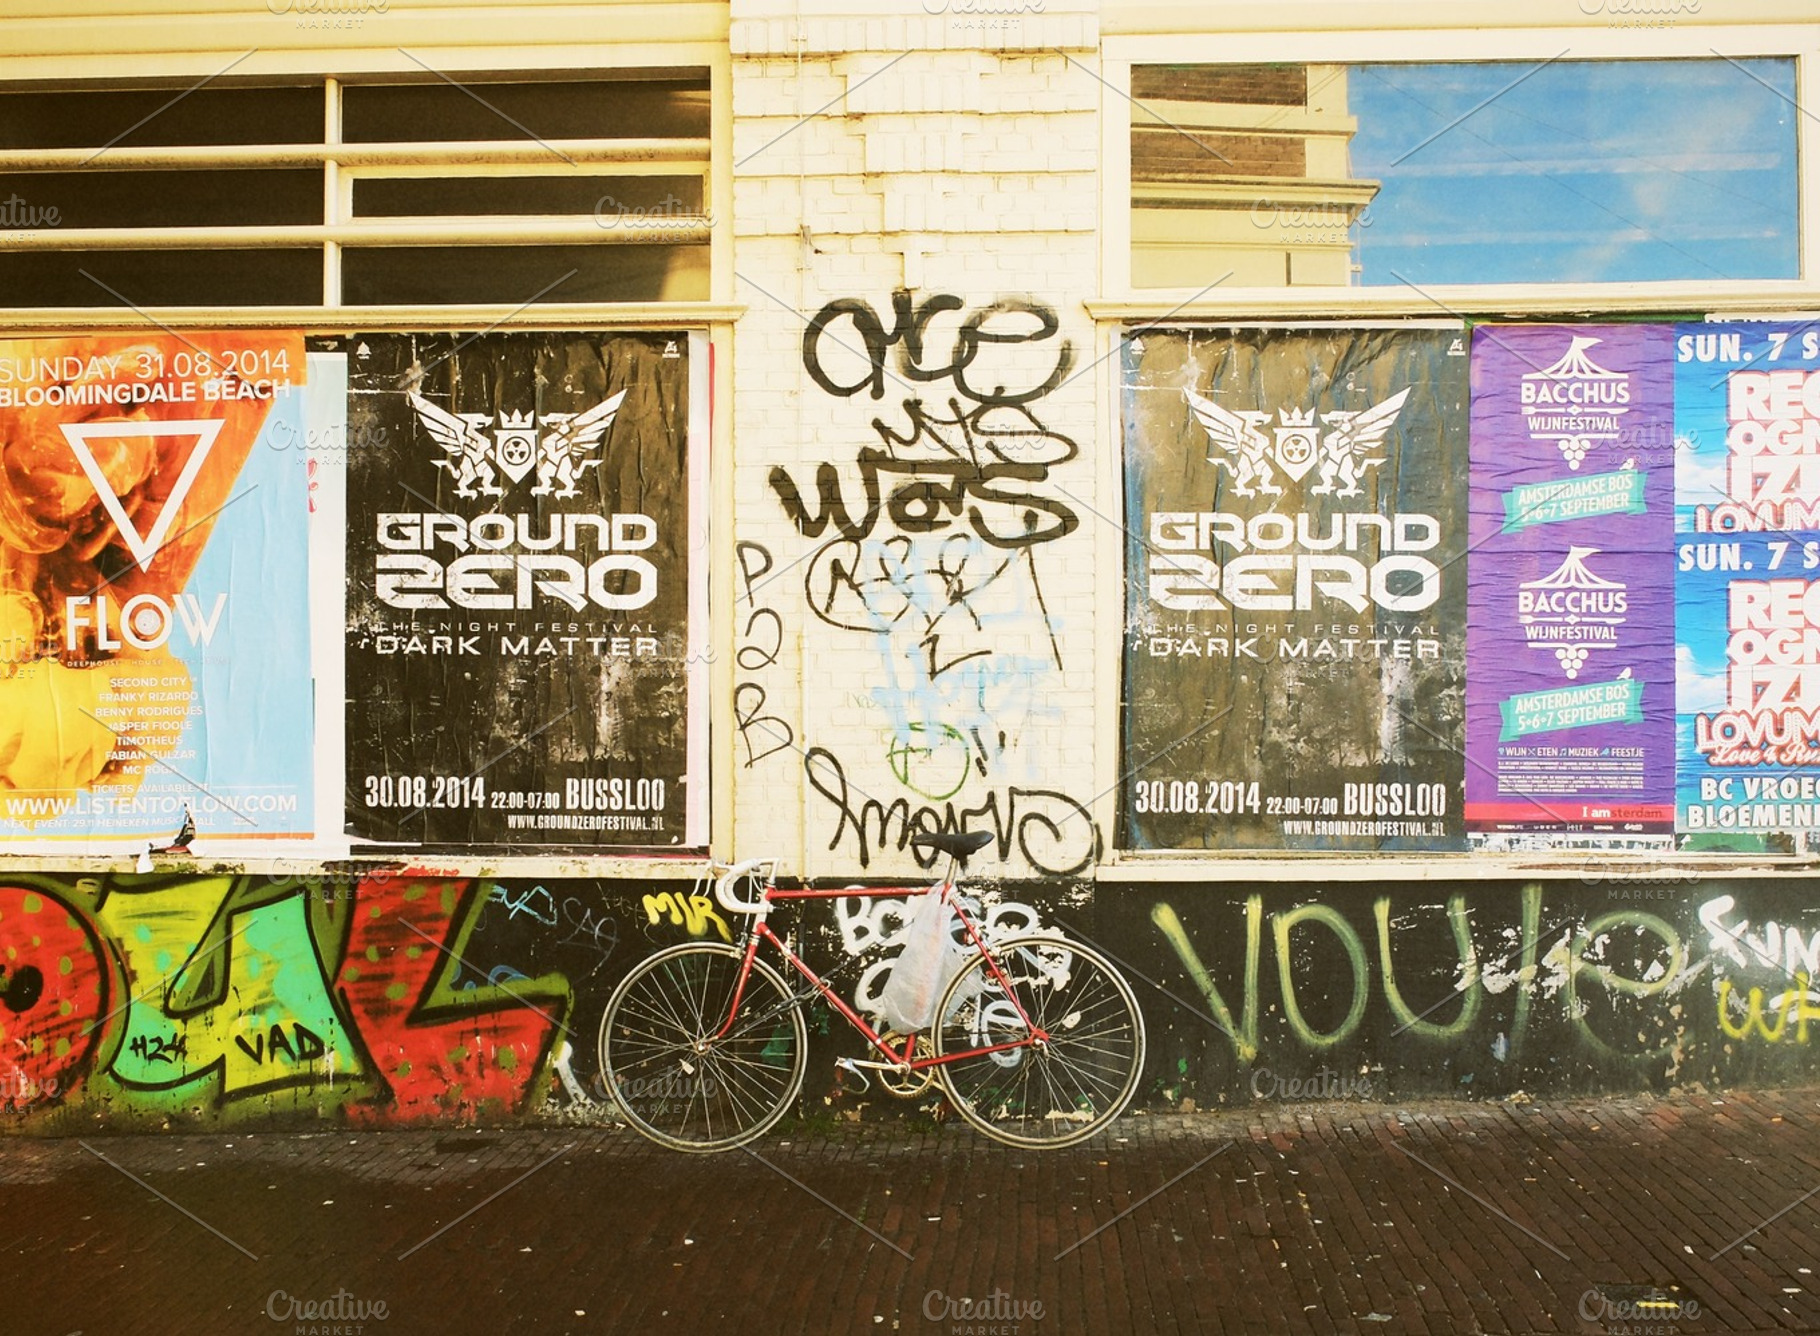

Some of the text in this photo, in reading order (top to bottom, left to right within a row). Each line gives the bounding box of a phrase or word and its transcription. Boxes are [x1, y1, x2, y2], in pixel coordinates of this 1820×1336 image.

[1677, 333, 1752, 362] SUN.
[1767, 332, 1789, 361] 7
[0, 349, 290, 383] SUNDAY 31.08.2014
[0, 379, 291, 407] BLOOMINGDALE BEACH
[1521, 382, 1630, 404] BACCHUS
[1527, 417, 1619, 430] WIJNFESTIVAL
[1518, 474, 1633, 506] AMSTERDAMSE BOS
[1560, 493, 1629, 516] SEPTEMBER
[376, 513, 657, 552] GROUND
[1150, 512, 1440, 552] GROUND
[1678, 543, 1753, 572] SUN.
[1767, 542, 1789, 571] 7
[376, 554, 657, 613] ZERO
[1150, 554, 1440, 614] ZERO
[1518, 592, 1628, 613] BACCHUS
[65, 593, 228, 650] FLOW
[441, 622, 516, 632] NIGHT
[535, 622, 657, 633] FESTIVAL
[1215, 624, 1295, 634] NIGHT
[1314, 624, 1439, 635] FESTIVAL
[1525, 626, 1617, 640] WIJNFESTIVAL
[376, 636, 658, 656] DARK MATTER
[1150, 638, 1439, 659] DARK MATTER
[110, 678, 158, 687] SECOND
[161, 677, 187, 686] CITY
[99, 691, 198, 702] FRANKY RIZARDO
[1515, 684, 1630, 714] AMSTERDAMSE BOS
[95, 705, 203, 717] BENNY RODRIGUES
[1557, 702, 1626, 725] SEPTEMBER
[117, 735, 183, 745] TIMOTHEUS
[105, 750, 196, 760] FABIAN GULZAR
[1505, 748, 1644, 757] WIJN ETEN MUZIEK FEESTJE
[123, 765, 141, 775] MC
[92, 785, 134, 794] TICKETS
[137, 784, 193, 793] AVAILABLE
[365, 775, 665, 811] 30.08.2014 22:00-07:00 BUSSLOO
[1135, 781, 1446, 817] 30.08.2014 22:00-07:00 BUSSLOO
[1701, 777, 1733, 800] BC
[1688, 804, 1820, 828] BLOEMEN
